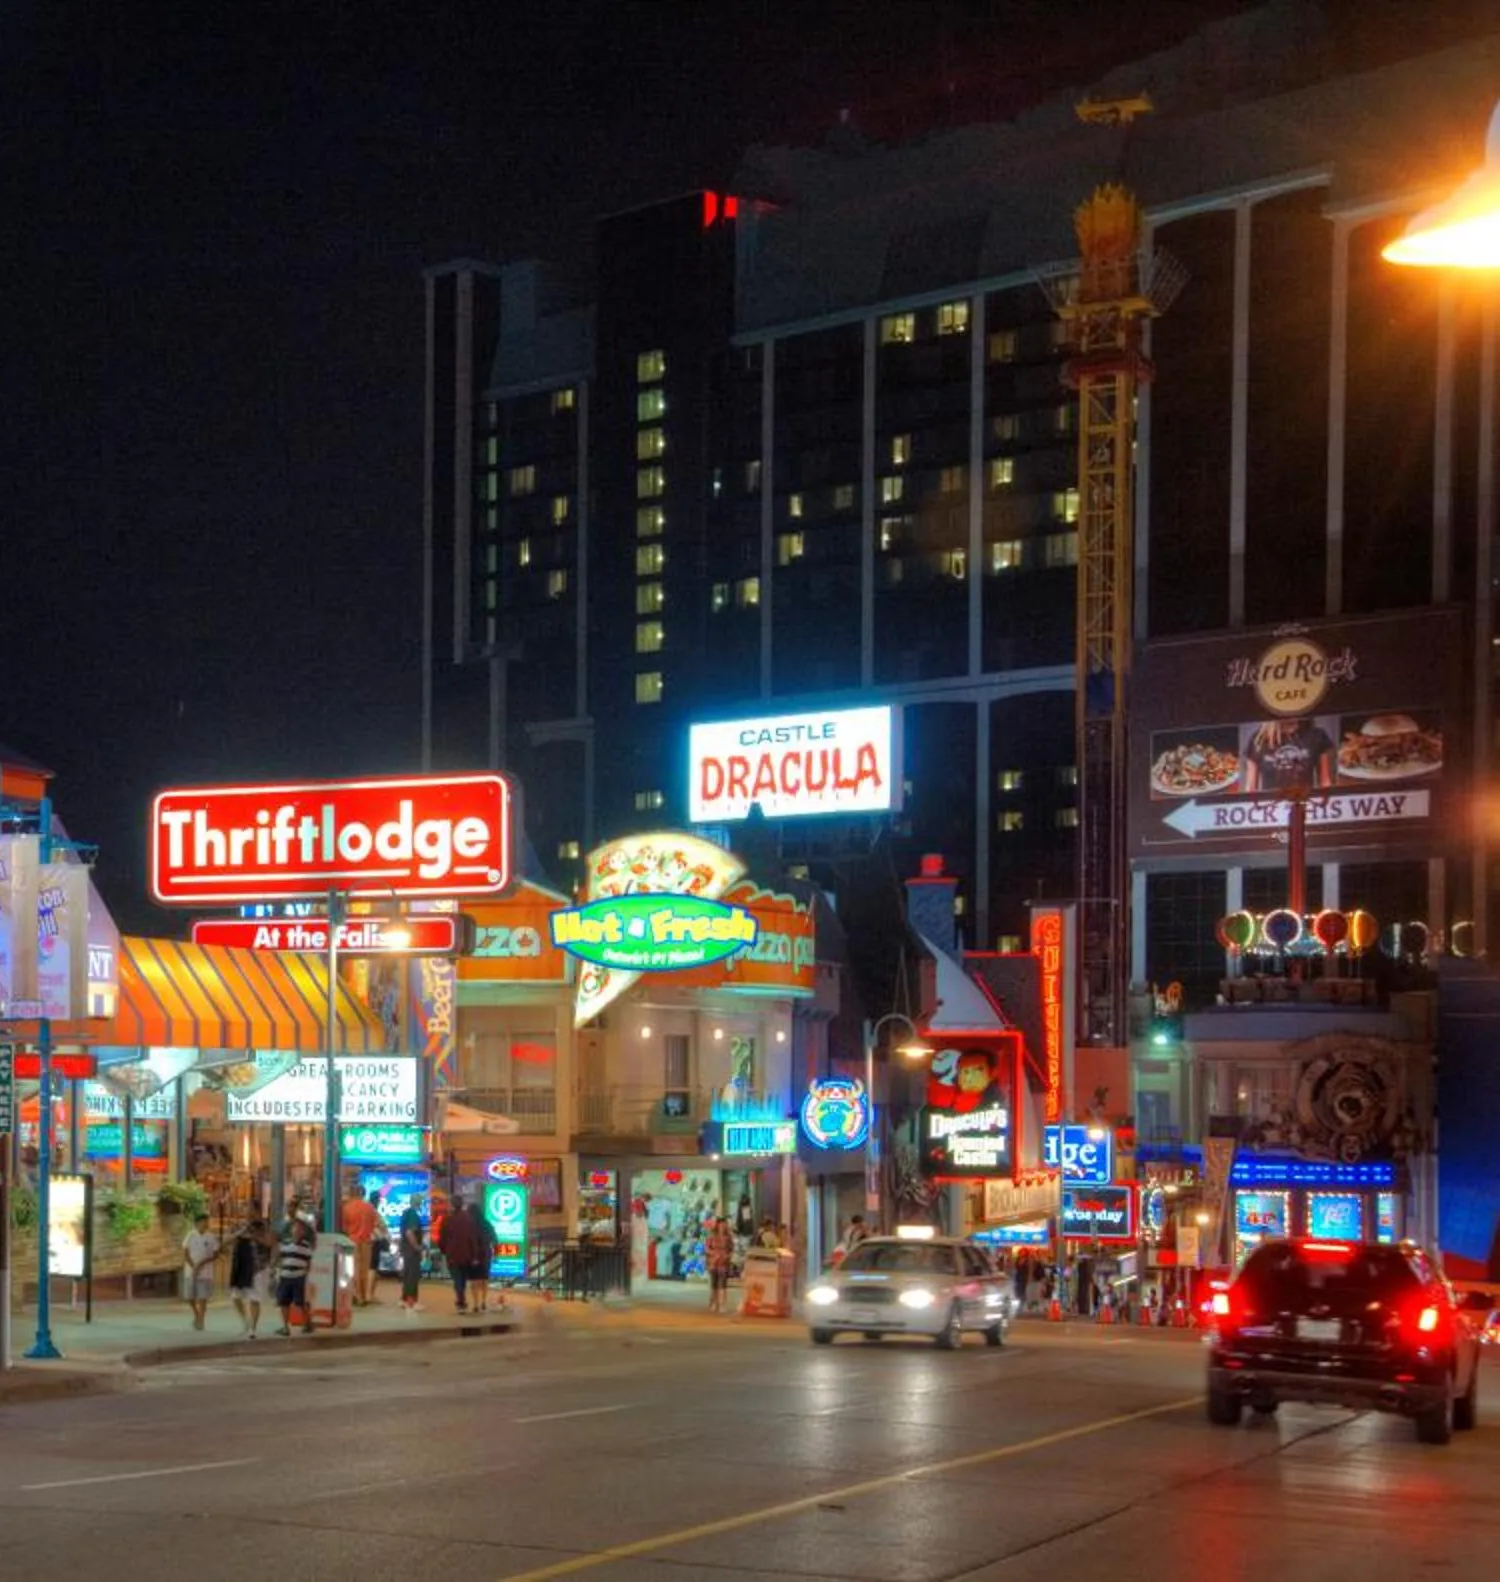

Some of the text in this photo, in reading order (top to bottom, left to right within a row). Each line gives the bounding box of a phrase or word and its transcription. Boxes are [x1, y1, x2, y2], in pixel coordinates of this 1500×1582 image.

[1227, 648, 1358, 687] Hard Rock
[1276, 689, 1308, 701] CAFE
[739, 721, 837, 746] CASTLE
[701, 741, 882, 802] DRACULA
[1214, 796, 1407, 826] ROCK HIS WAY
[161, 801, 491, 879] Thriftlodge
[254, 927, 281, 948] At
[287, 926, 326, 947] the
[552, 908, 757, 944] Hot Fresh
[426, 977, 451, 1034] Beer
[345, 1063, 400, 1079] ROOMS
[346, 1082, 400, 1098] CANCY
[228, 1100, 302, 1117] INCLUDES
[345, 1101, 416, 1118] PARKING
[490, 1162, 528, 1176] OPEN
